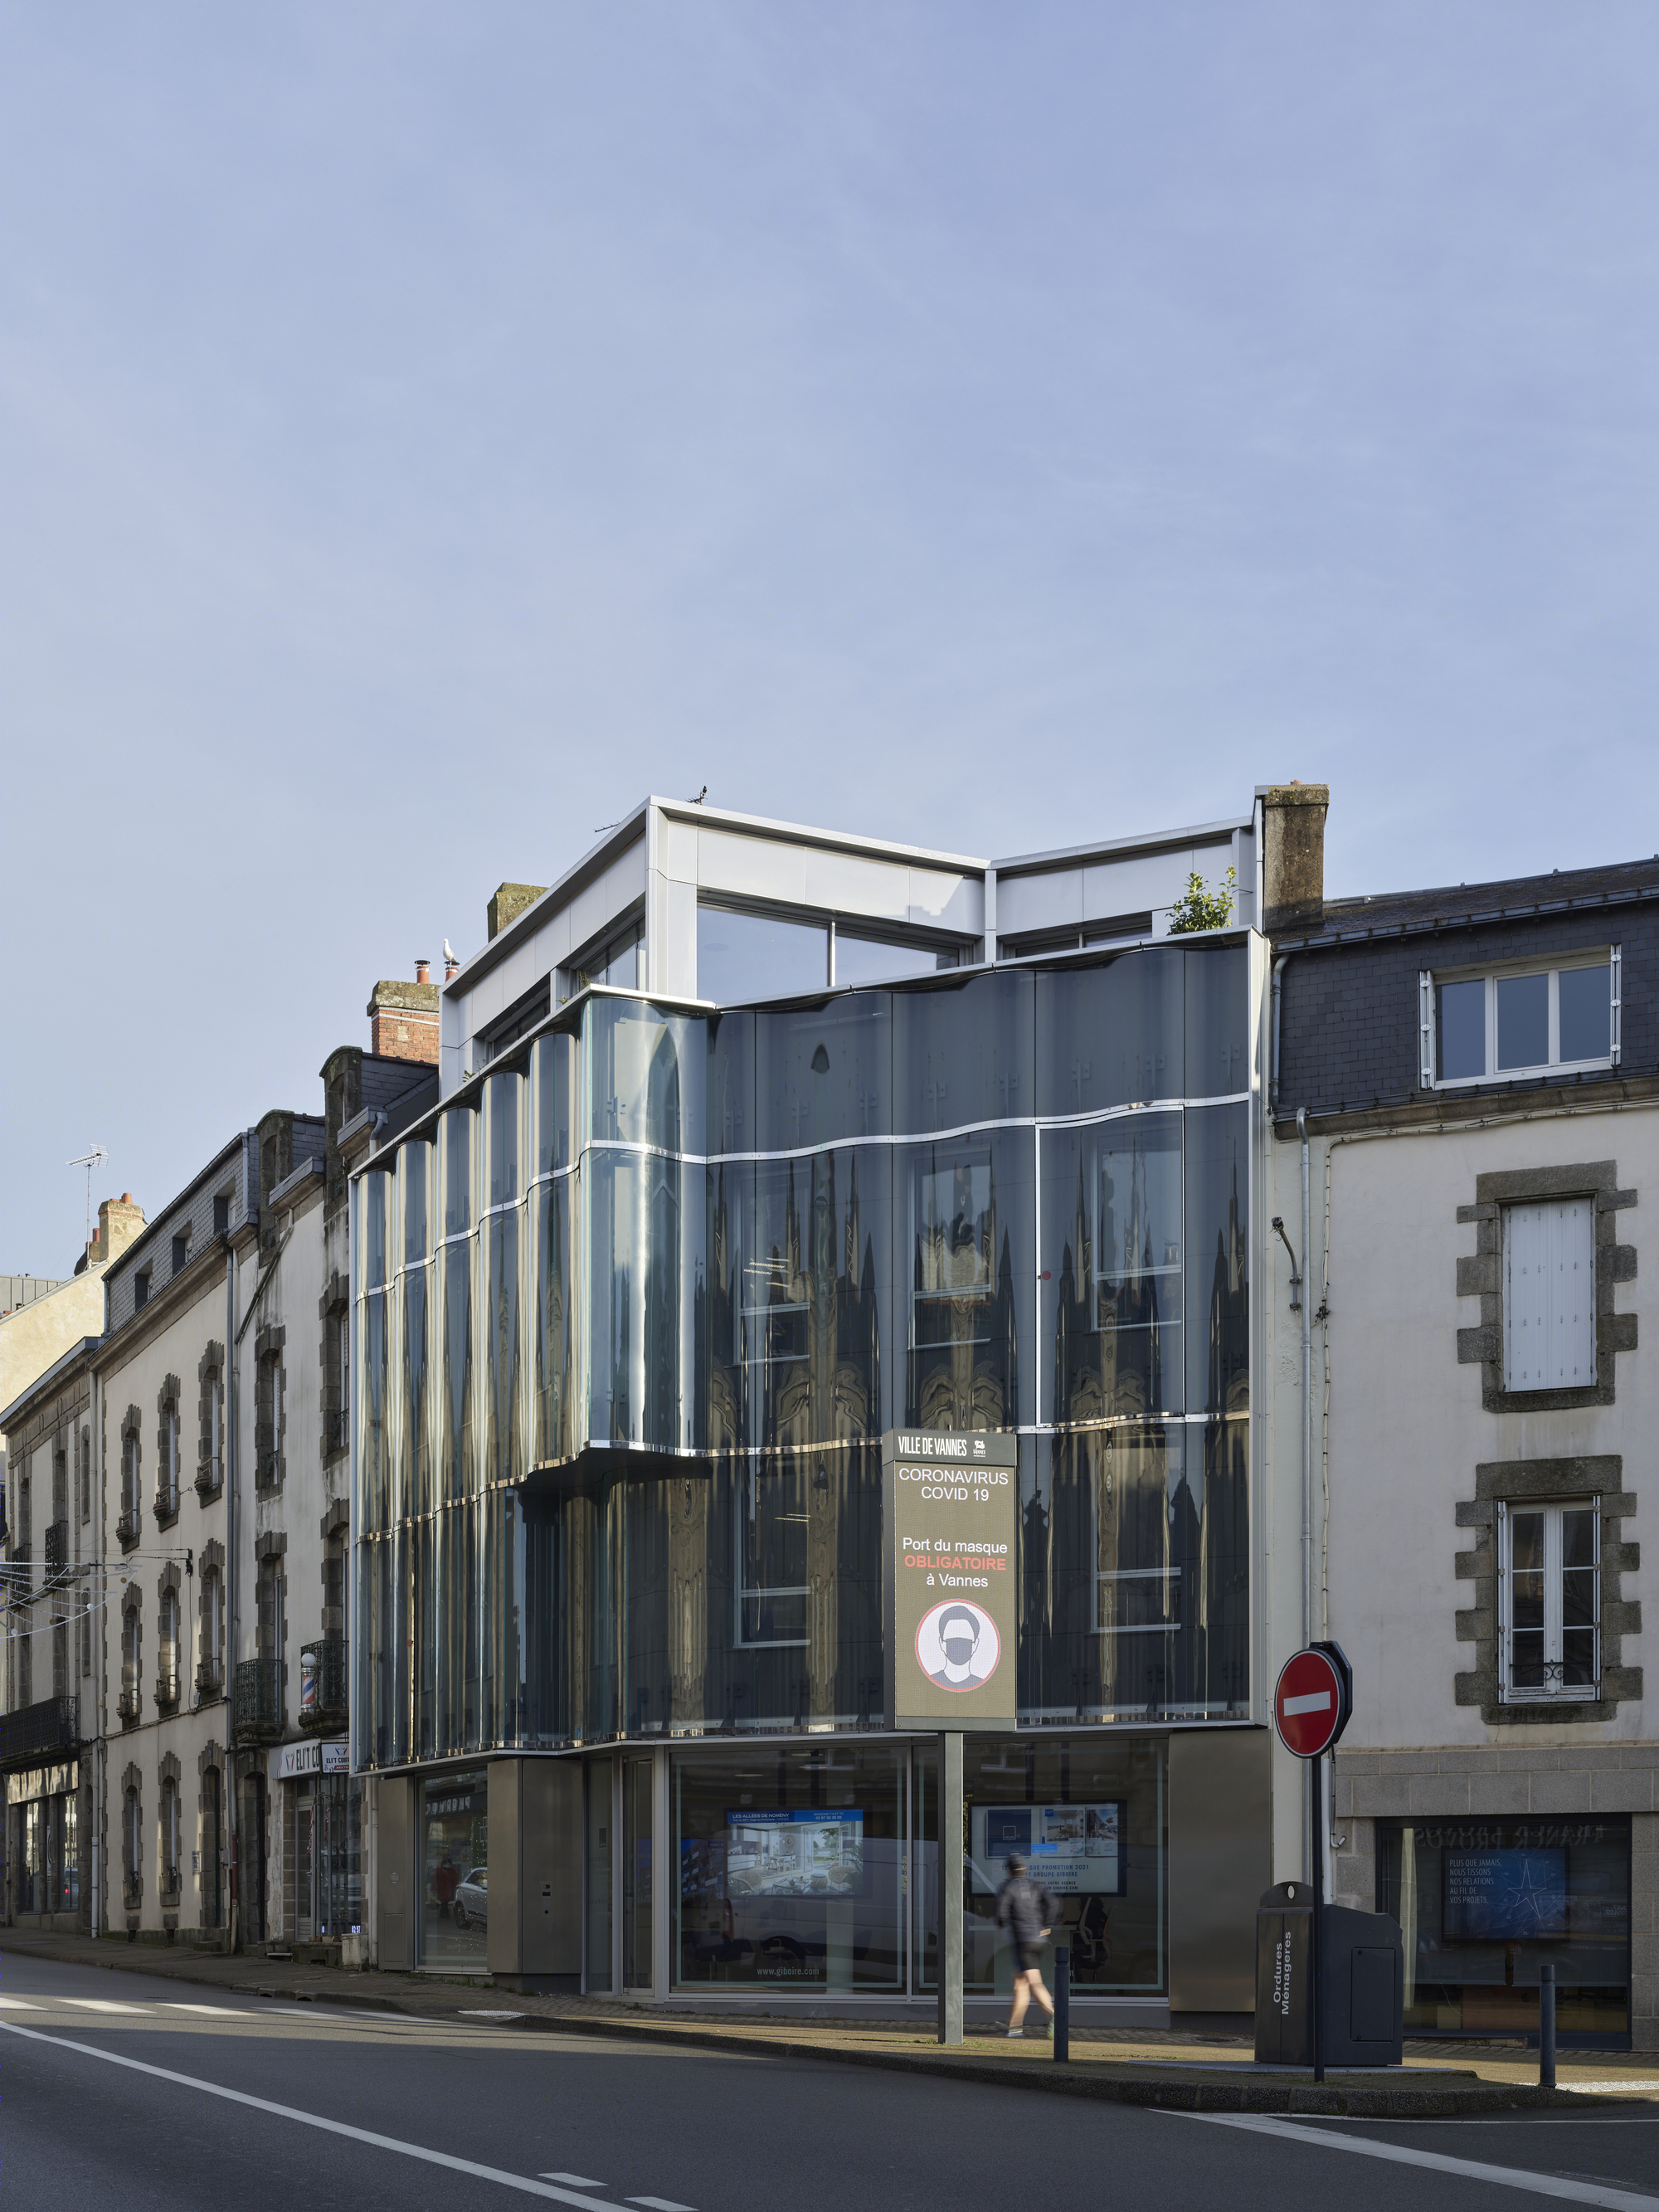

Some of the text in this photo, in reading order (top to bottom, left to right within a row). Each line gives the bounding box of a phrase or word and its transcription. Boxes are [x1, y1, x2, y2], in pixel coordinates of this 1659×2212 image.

[898, 1436, 967, 1456] VILLE DE VANNES
[899, 1468, 1009, 1485] CORONAVIRUS
[922, 1486, 989, 1501] COVID 19
[902, 1537, 1008, 1556] Port du masque
[904, 1555, 1006, 1571] OBLIGATOIRE
[927, 1573, 989, 1587] à Vannes
[1479, 1859, 1502, 1867] JAMAIS,
[1467, 1868, 1491, 1876] TISSONS
[1449, 1896, 1488, 1904] VOS PROJETS.
[757, 1966, 820, 1976] www.giboire.com
[1273, 1942, 1282, 2003] Ordures
